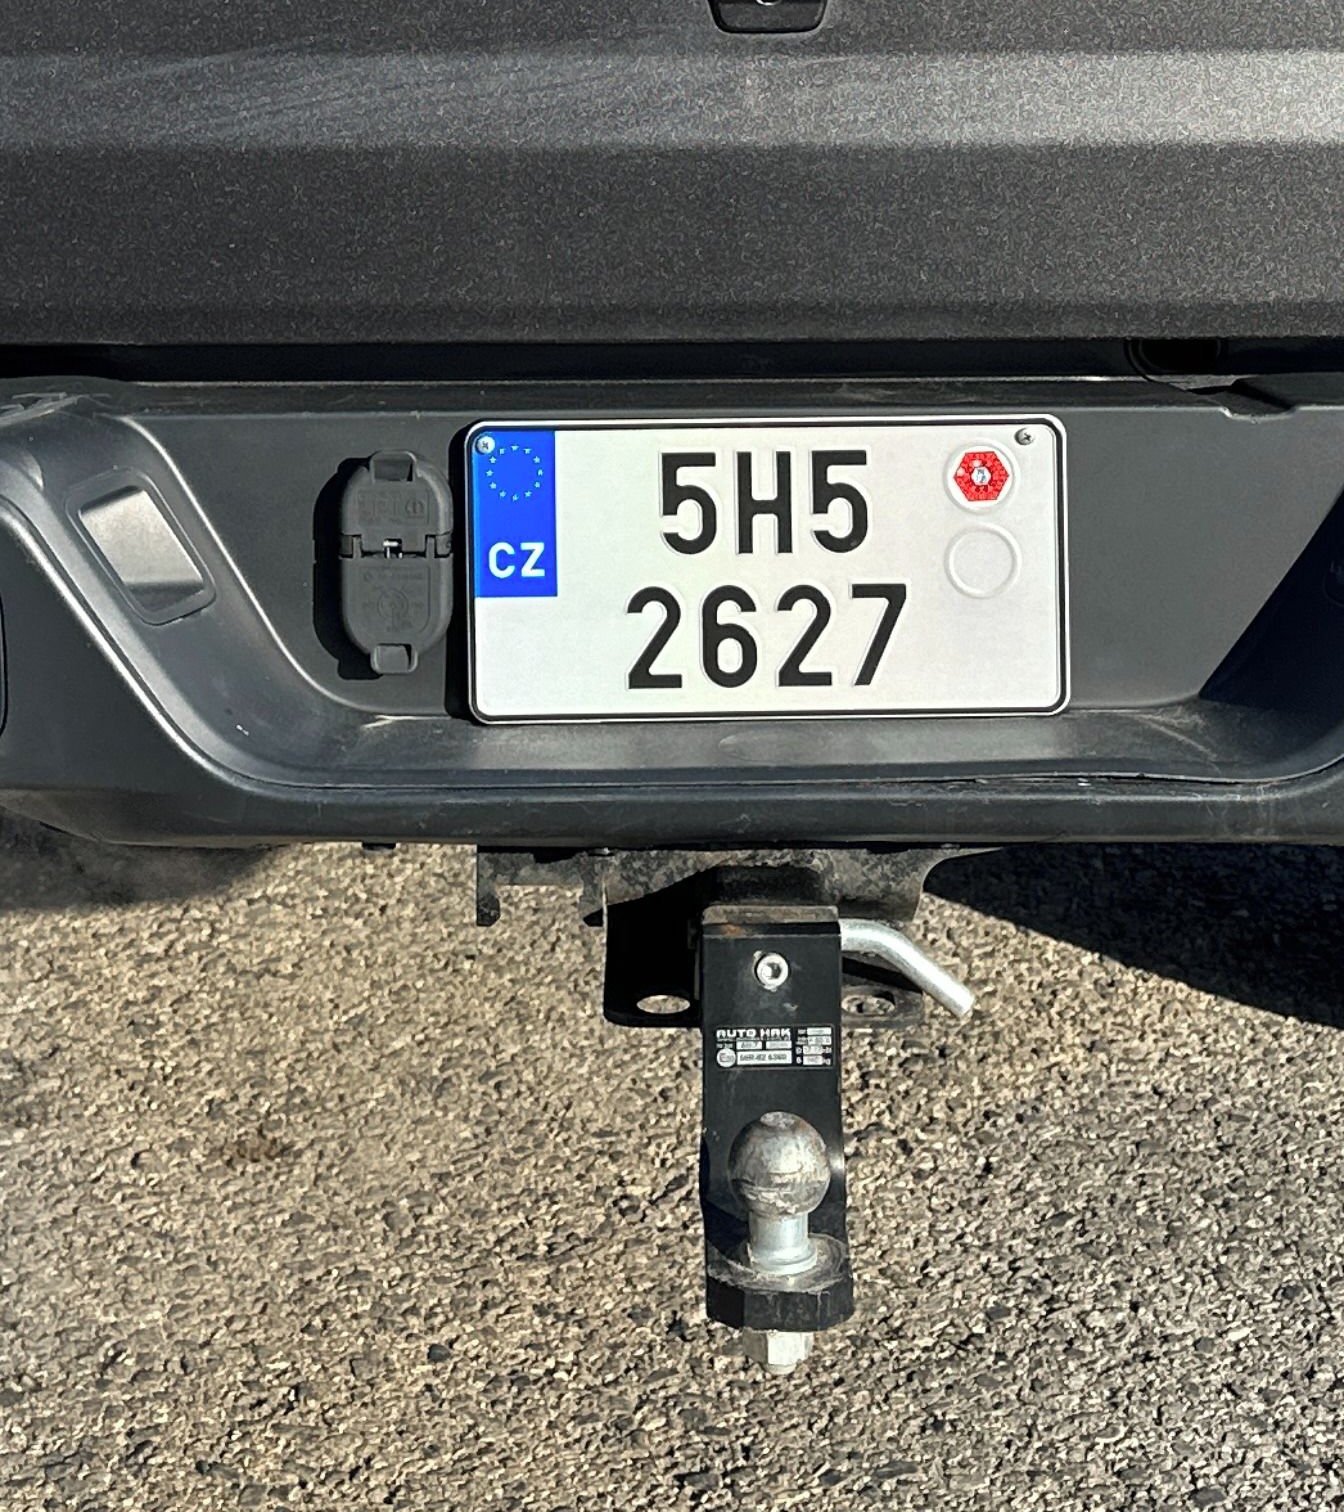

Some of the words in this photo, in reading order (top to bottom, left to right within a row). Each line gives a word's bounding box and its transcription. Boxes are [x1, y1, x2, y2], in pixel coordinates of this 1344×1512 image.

[660, 449, 869, 556] 5H5
[488, 541, 546, 579] CZ
[625, 582, 908, 690] 2627
[716, 1029, 756, 1038] AUTO
[760, 1028, 791, 1038] HAK
